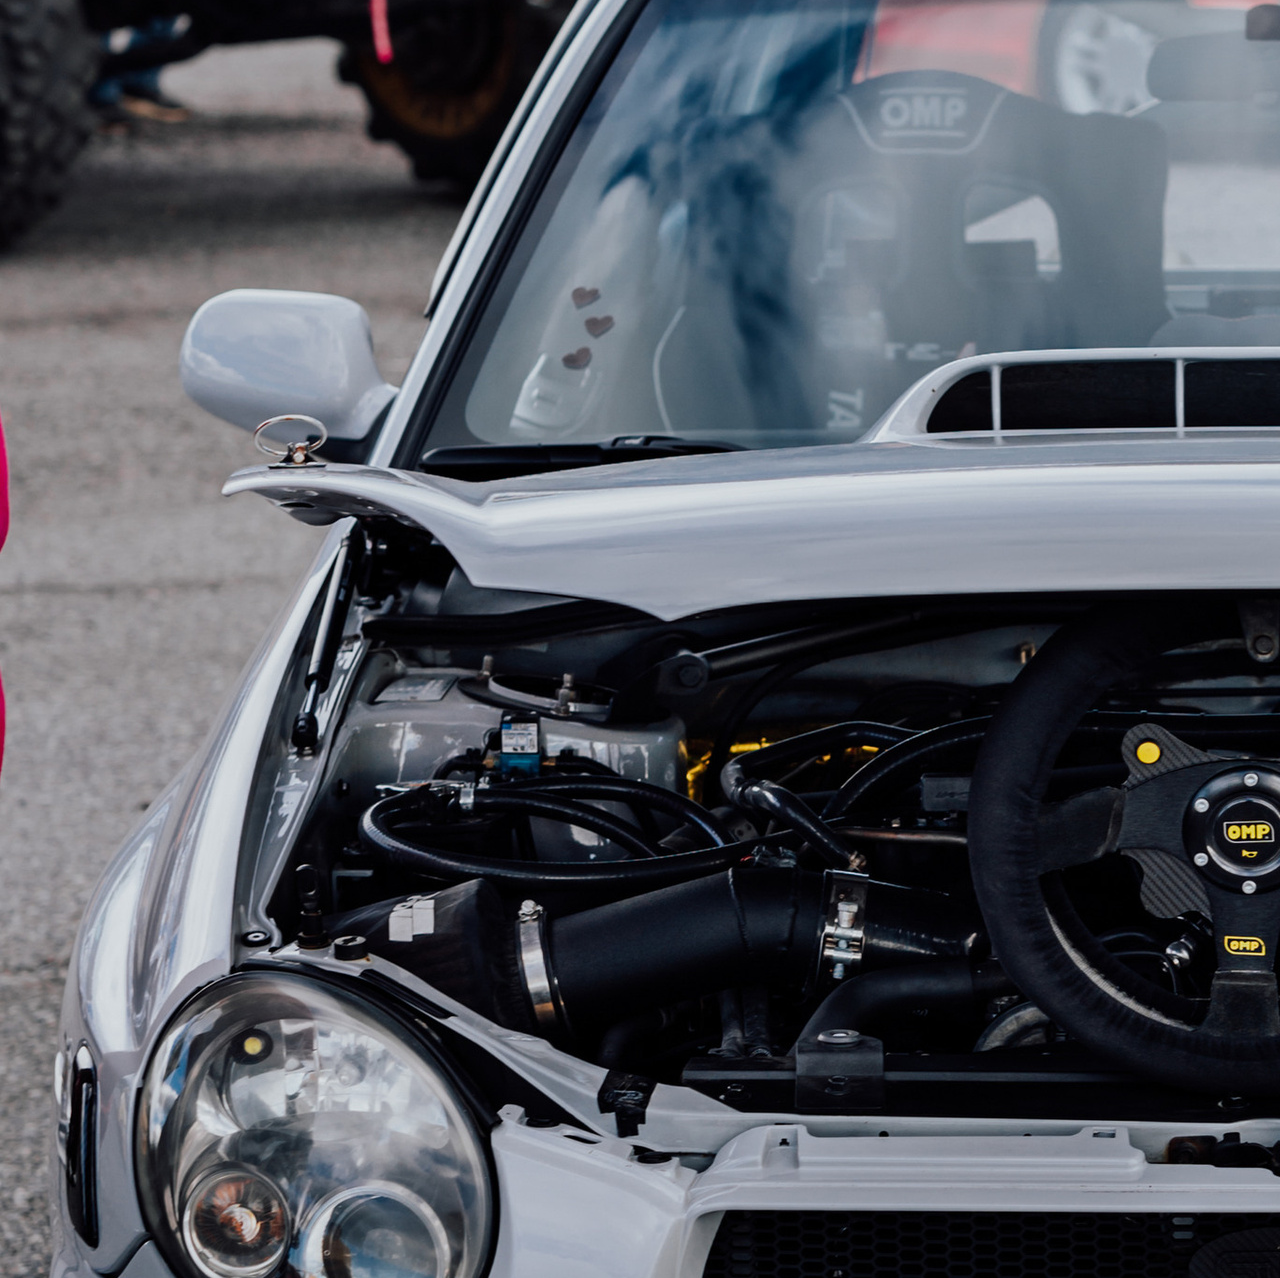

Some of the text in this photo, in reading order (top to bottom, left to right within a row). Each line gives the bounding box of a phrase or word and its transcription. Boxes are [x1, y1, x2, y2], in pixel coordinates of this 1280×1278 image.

[882, 95, 965, 127] OMP
[1228, 824, 1270, 840] OMP
[1229, 940, 1260, 951] OMP
